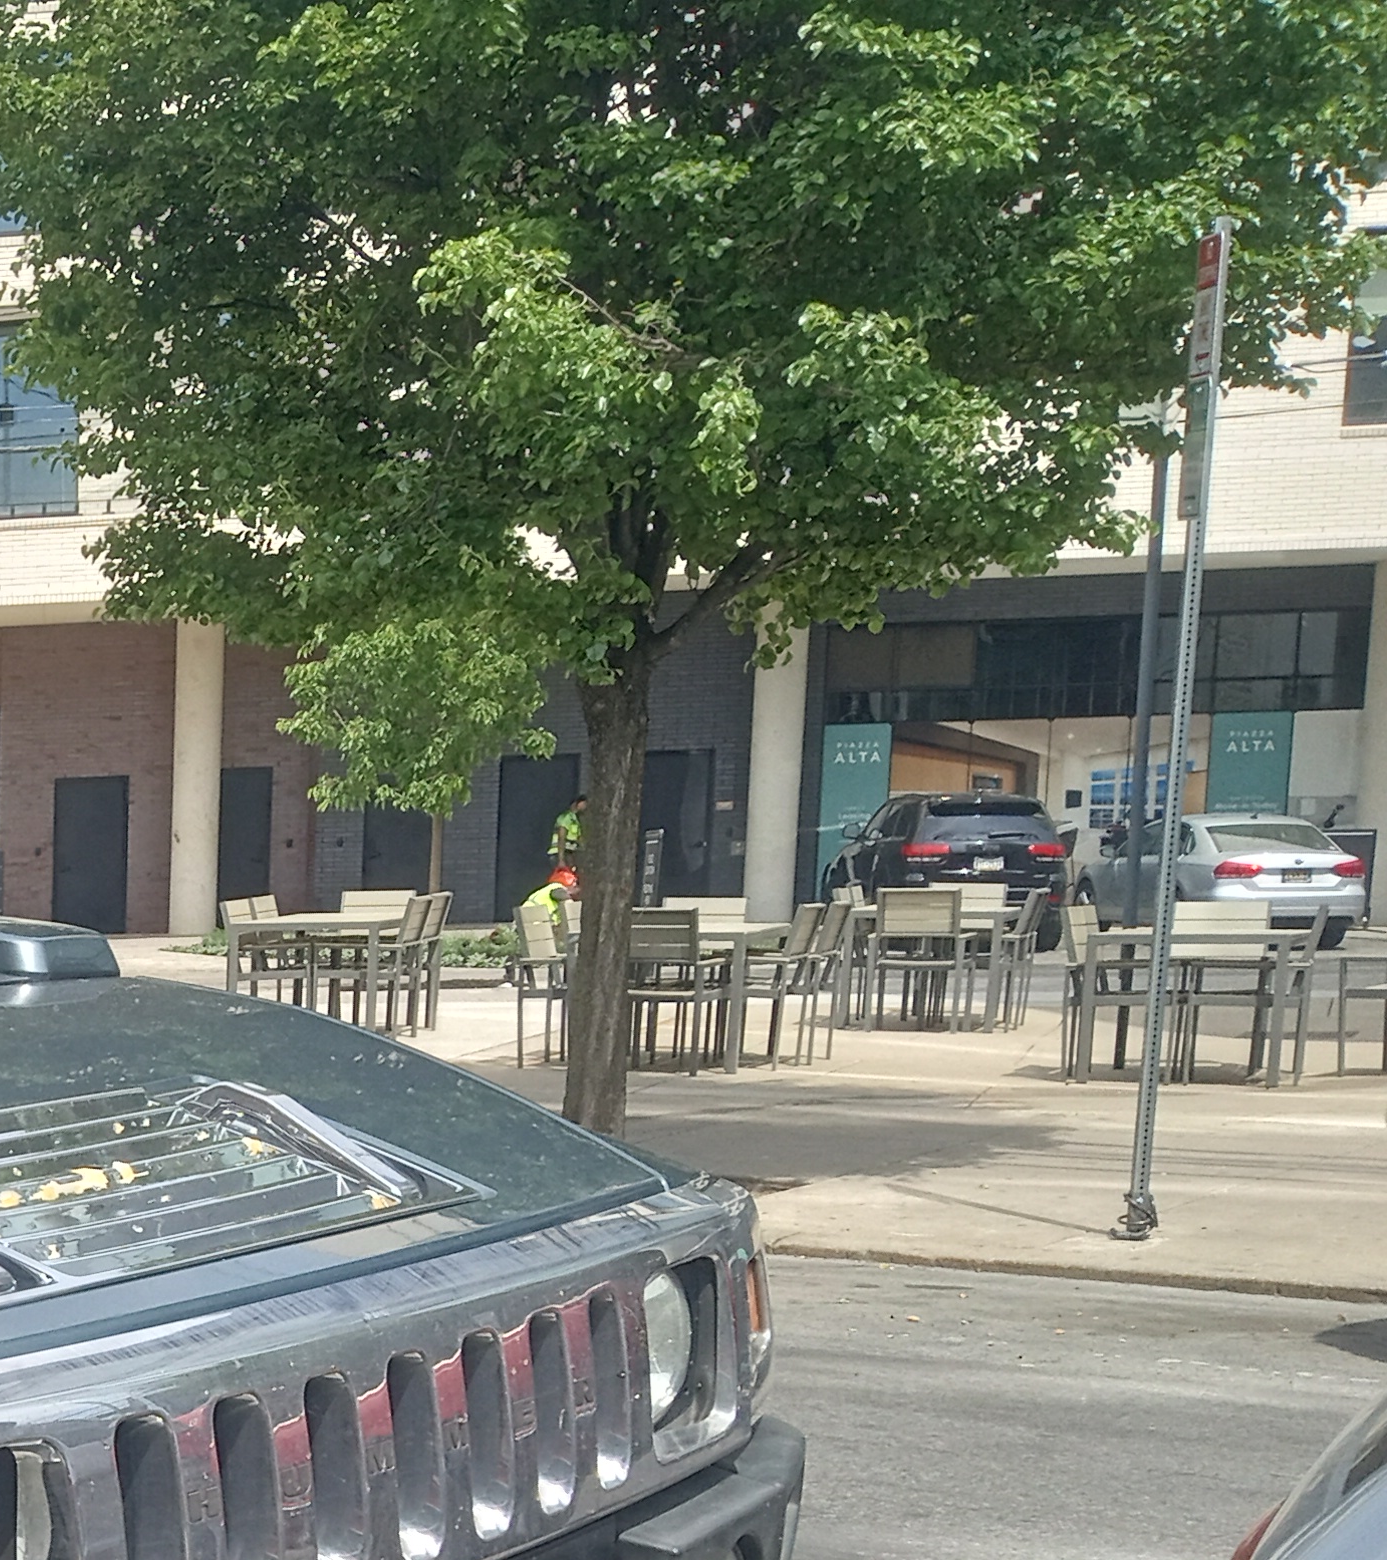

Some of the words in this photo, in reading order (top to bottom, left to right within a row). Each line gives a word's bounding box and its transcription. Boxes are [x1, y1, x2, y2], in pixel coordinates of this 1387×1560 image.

[1228, 729, 1275, 738] PIAZZA
[835, 741, 880, 749] PIAZZA
[1227, 740, 1276, 753] ALTA
[833, 750, 882, 764] ALTA
[186, 1377, 597, 1524] HUMMER
